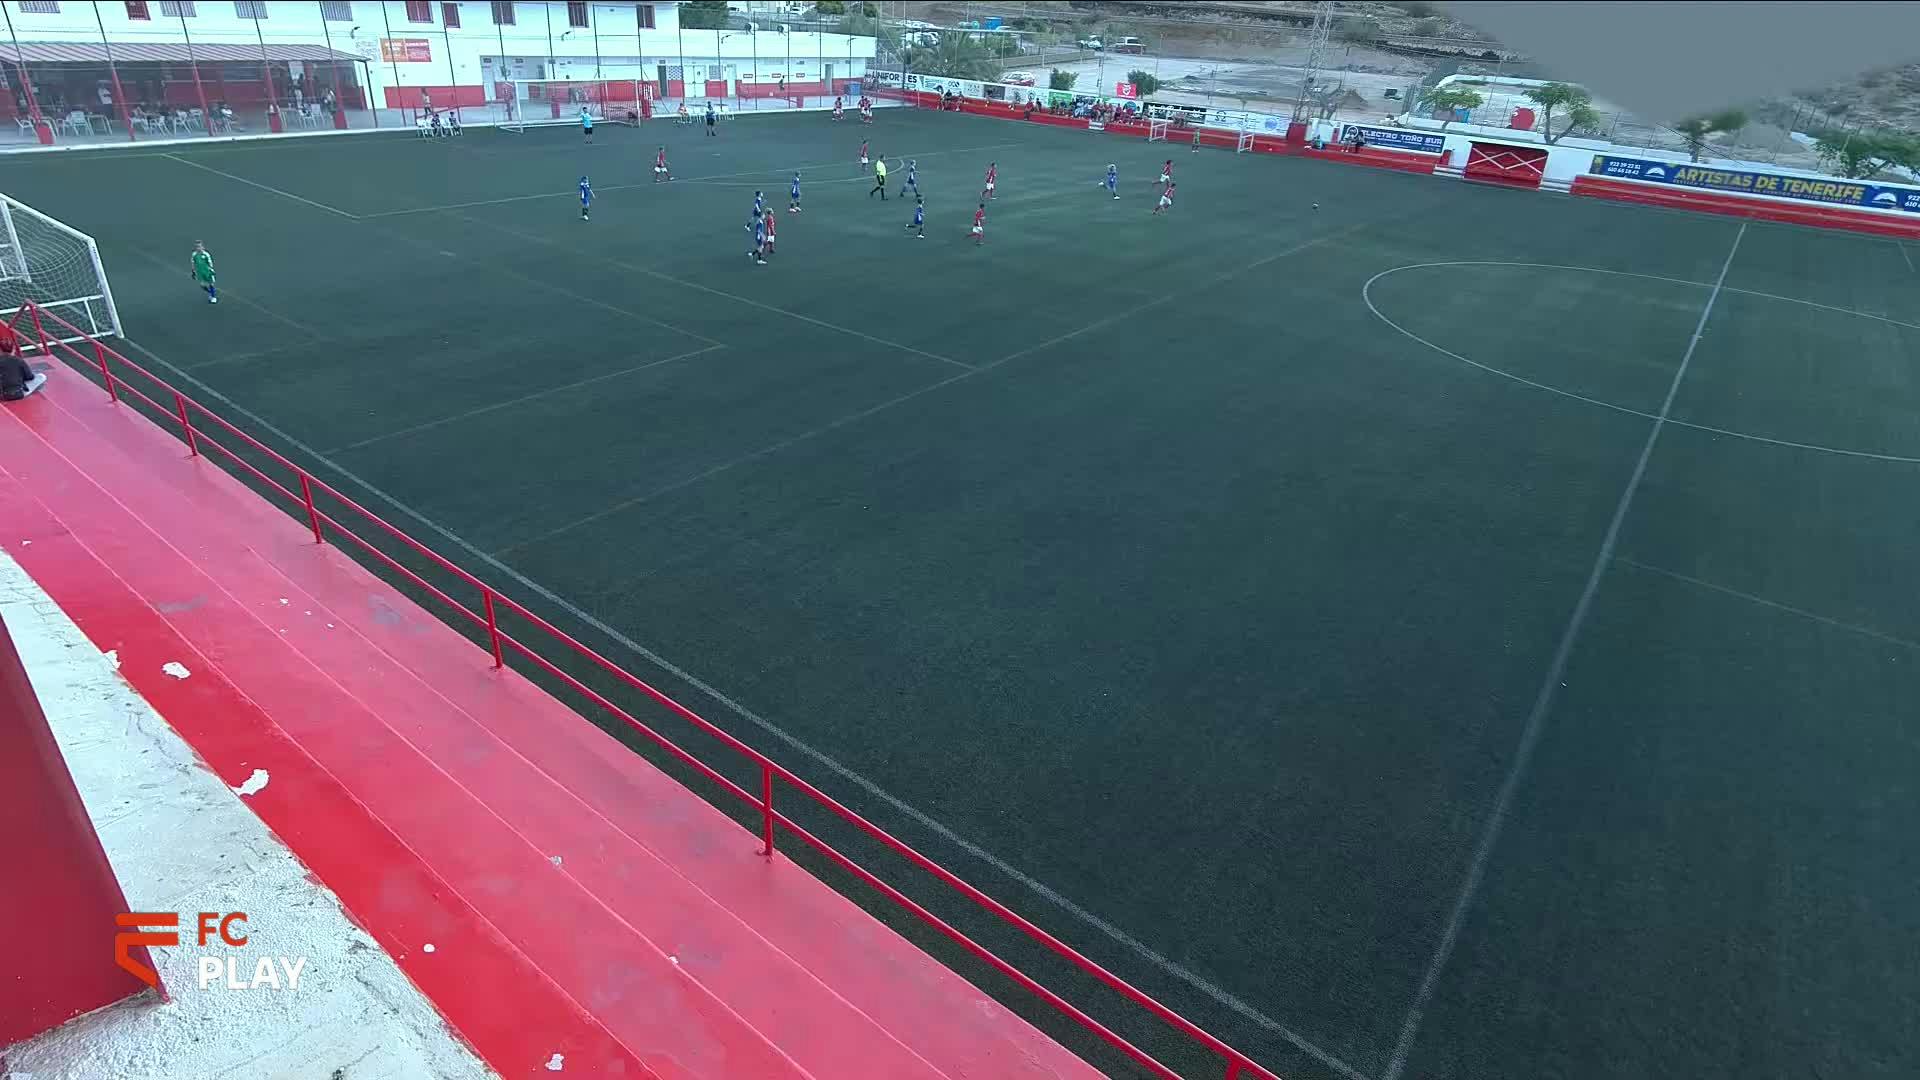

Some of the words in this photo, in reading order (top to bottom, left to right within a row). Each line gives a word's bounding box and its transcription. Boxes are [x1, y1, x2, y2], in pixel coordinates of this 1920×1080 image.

[871, 71, 917, 83] UNIFORES
[1674, 167, 1753, 187] ARTISTAS
[1755, 176, 1780, 190] DE
[1782, 178, 1866, 200] TENERIFE
